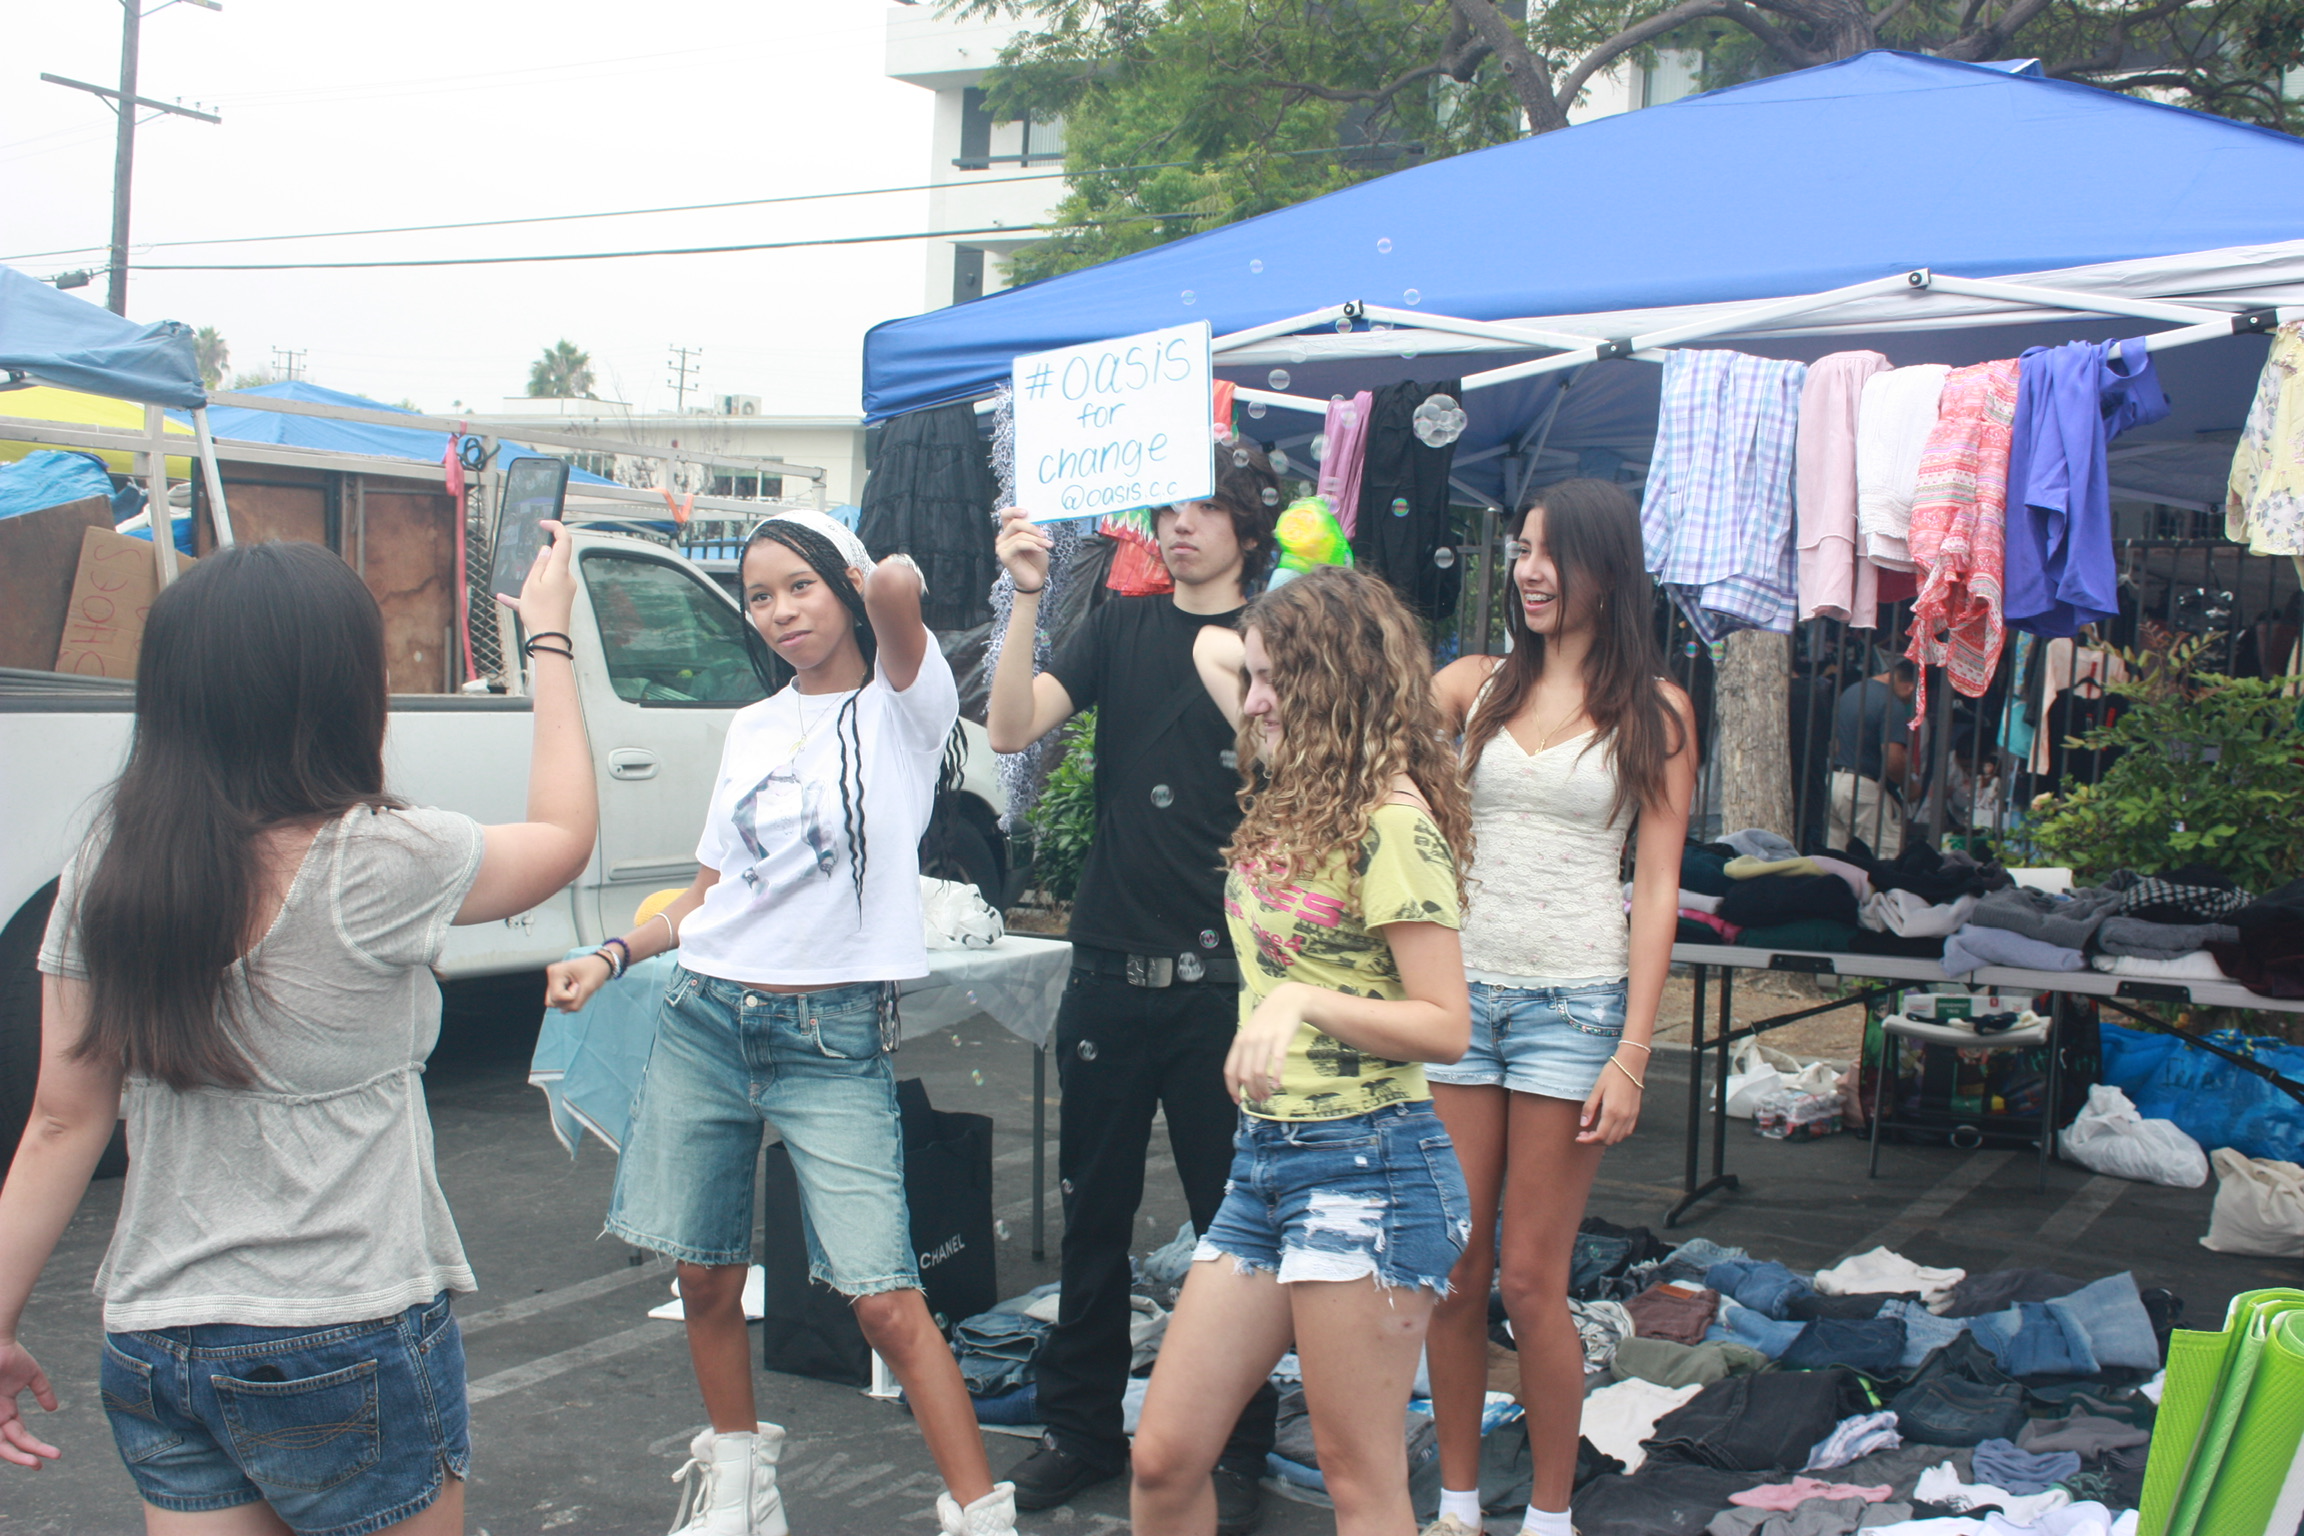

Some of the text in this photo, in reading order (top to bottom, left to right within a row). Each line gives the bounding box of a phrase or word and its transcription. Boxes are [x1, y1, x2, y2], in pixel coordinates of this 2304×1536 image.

[1076, 403, 1127, 428] for
[1038, 433, 1168, 484] change
[920, 1233, 966, 1270] CHANEL
